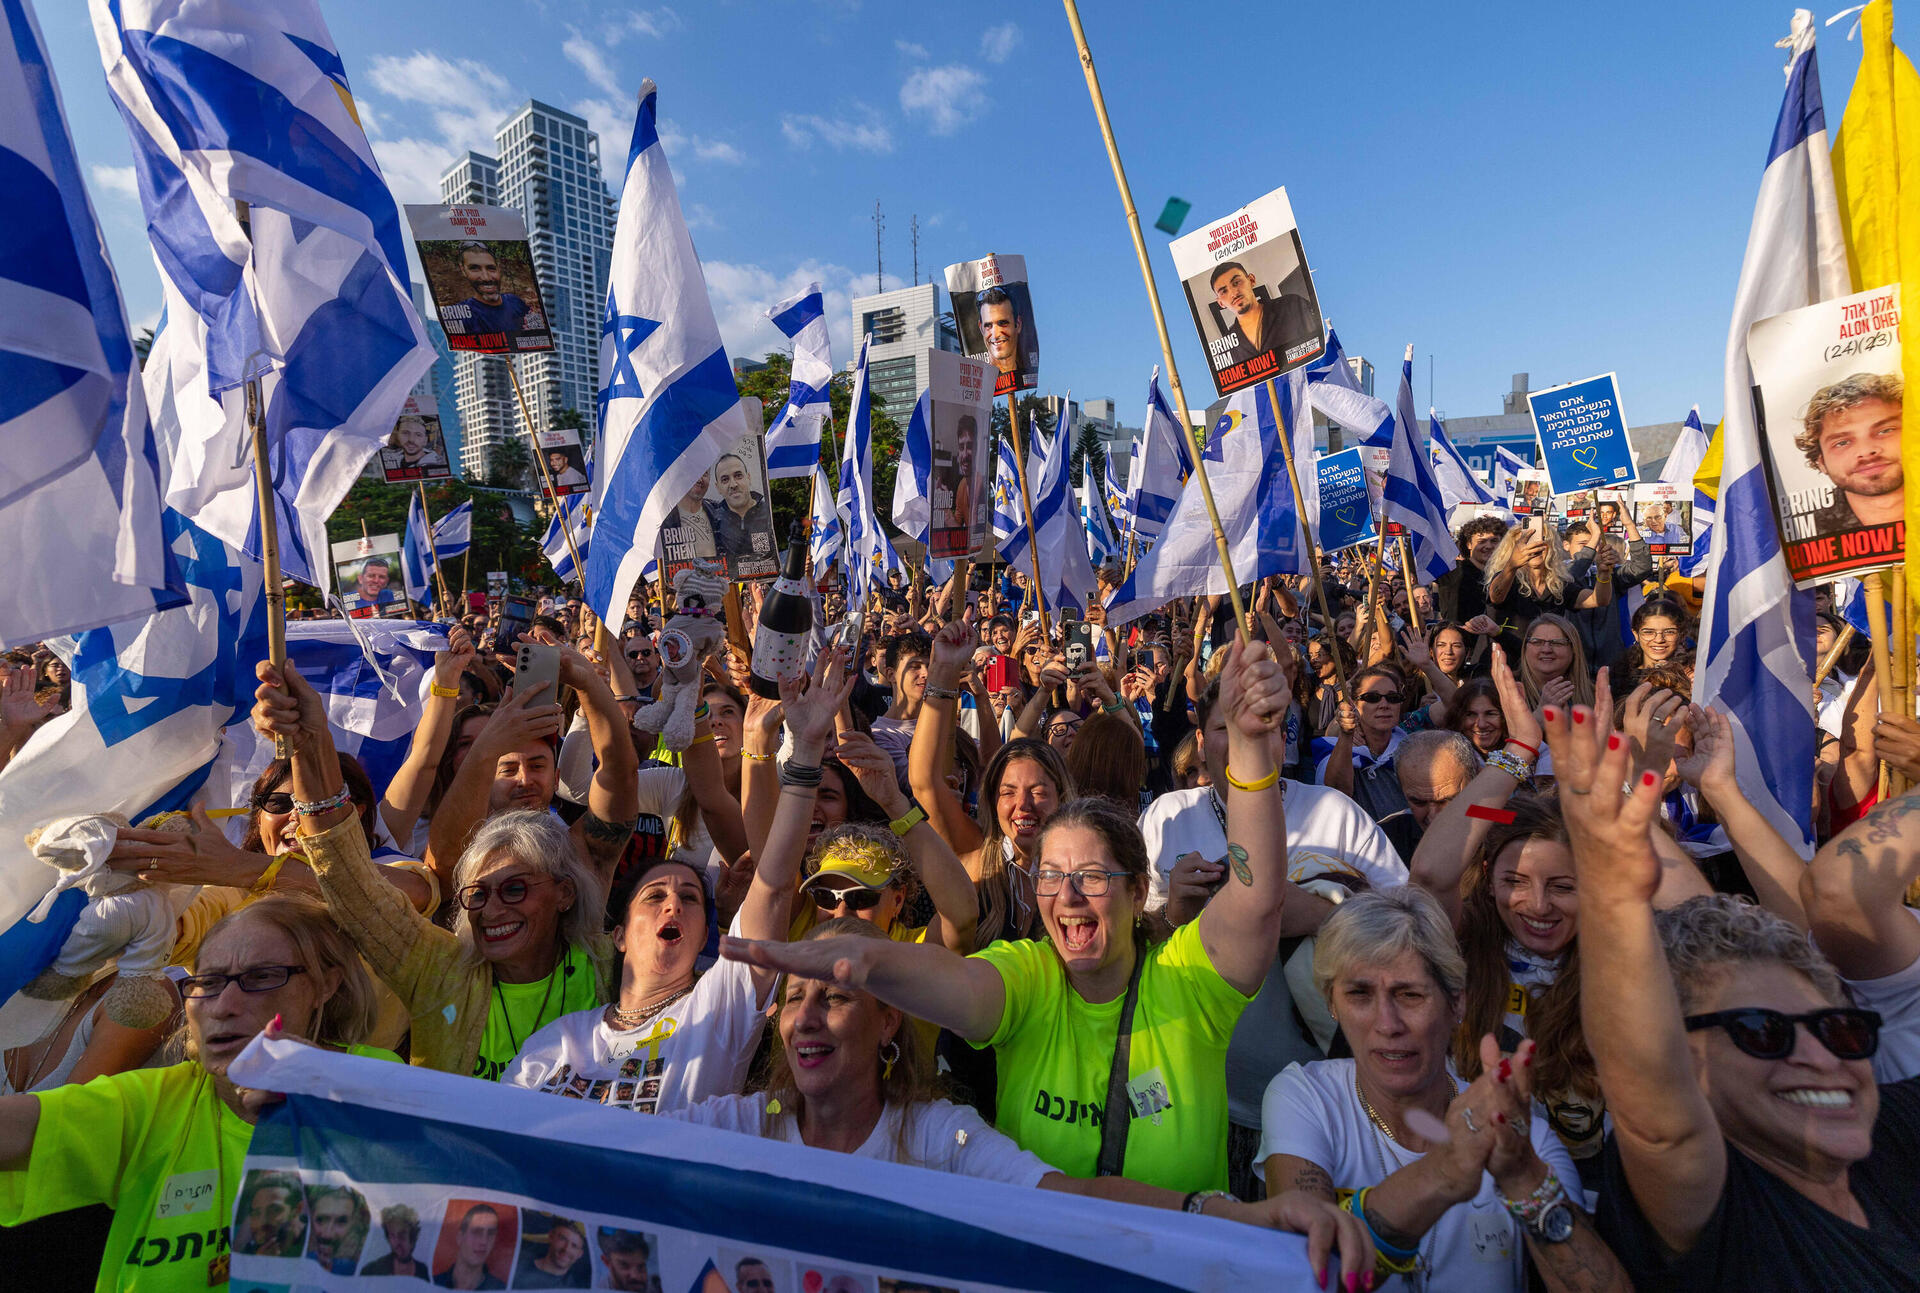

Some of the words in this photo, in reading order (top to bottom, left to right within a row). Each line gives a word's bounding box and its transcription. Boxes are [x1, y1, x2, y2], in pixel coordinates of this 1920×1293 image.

[1238, 214, 1250, 228] רום
[1208, 238, 1222, 252] ROM
[1222, 221, 1258, 246] BRASLAVSKI
[1209, 220, 1238, 240] ברסלבסקי
[440, 304, 472, 320] BRING
[1842, 304, 1866, 322] אהל
[1869, 294, 1894, 316] אלון
[444, 320, 466, 334] HIM
[1840, 320, 1871, 340] ALON
[450, 335, 477, 349] HOME
[478, 332, 508, 348] NOW!
[1208, 333, 1240, 356] BRING
[1213, 352, 1234, 371] HIM
[1218, 362, 1248, 386] HOME
[1249, 350, 1278, 374] NOW!
[995, 371, 1016, 390] NOW!
[1560, 395, 1584, 408] אתם
[1570, 399, 1612, 416] הנשימה
[1540, 410, 1567, 422] והאור
[1577, 409, 1610, 424] שלהם
[1546, 419, 1574, 432] חיכינו,
[1557, 422, 1602, 439] מאושרים
[1552, 438, 1576, 450] בבית
[1579, 429, 1613, 444] שאתם
[1320, 464, 1340, 475] אתם
[1329, 467, 1361, 480] הנשימה
[1336, 475, 1361, 487] שלהם
[933, 490, 953, 509] BRING
[1320, 485, 1356, 501] מאושרים
[1339, 491, 1365, 504] שאתם
[1779, 486, 1836, 518] BRING
[933, 509, 945, 528] HIM
[663, 527, 696, 544] BRING
[1782, 513, 1818, 542] HIM
[932, 530, 948, 549] HOME
[1788, 538, 1838, 570] HOME
[1842, 522, 1906, 558] NOW!
[666, 544, 697, 561] THEM
[668, 562, 694, 578] HOM
